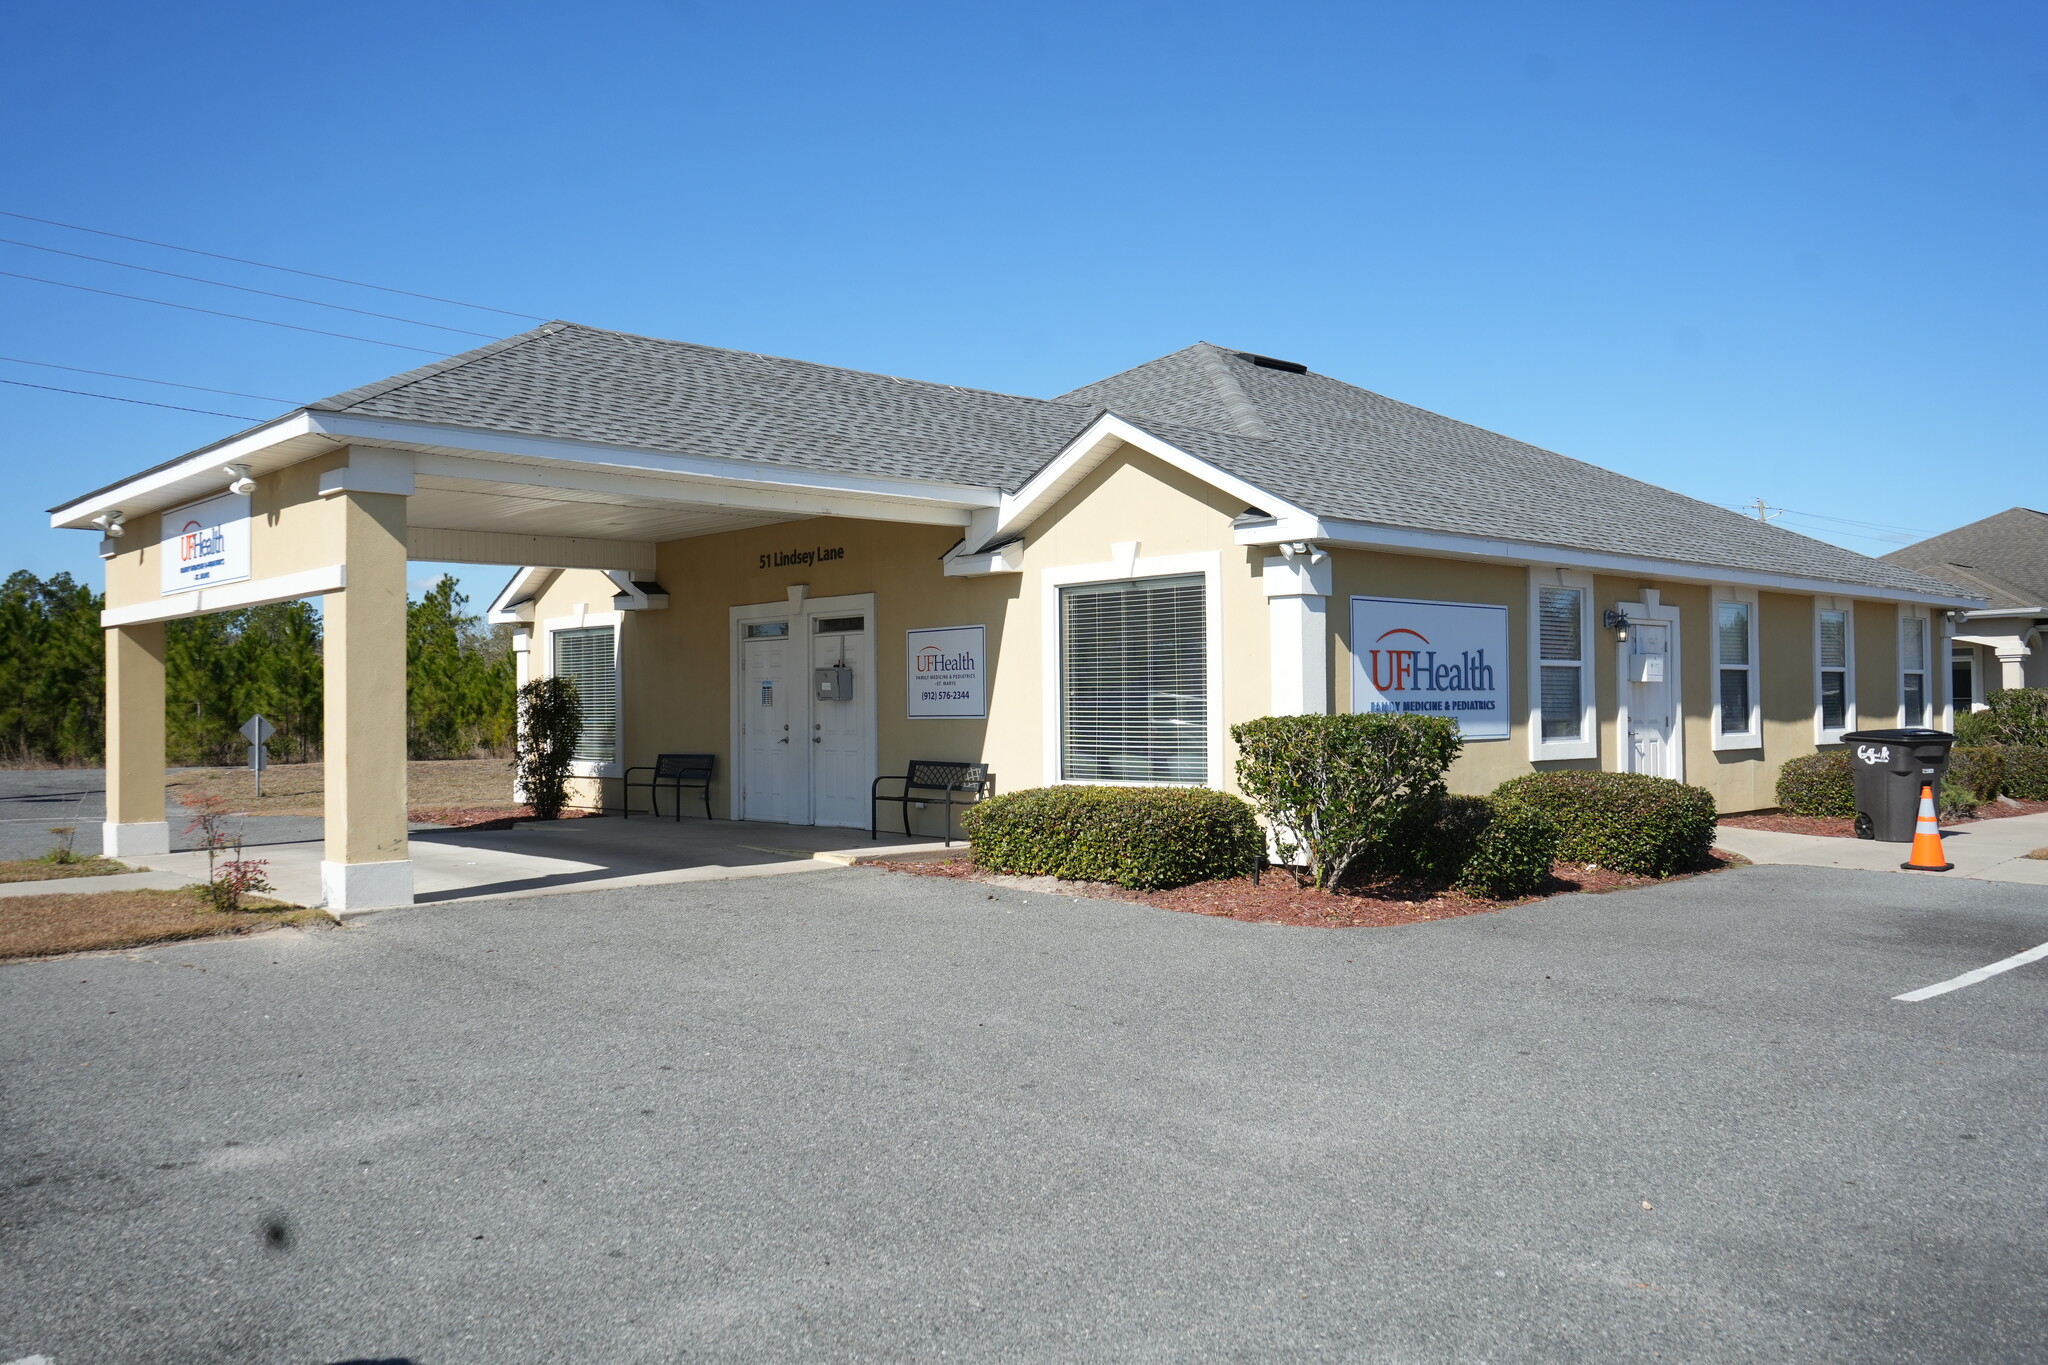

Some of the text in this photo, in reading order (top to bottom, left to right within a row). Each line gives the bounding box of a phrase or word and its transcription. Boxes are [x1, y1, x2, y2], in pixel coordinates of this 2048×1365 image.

[181, 524, 225, 561] UFHealth
[759, 546, 845, 569] 51 Lindsey Lane
[916, 651, 975, 673] UFHealth
[1369, 648, 1496, 692] UFHealth
[921, 690, 970, 701] (912) 576-2344
[1403, 701, 1443, 712] MEDICINE
[1444, 701, 1451, 711] &
[1452, 700, 1496, 711] PEDIATRICS
